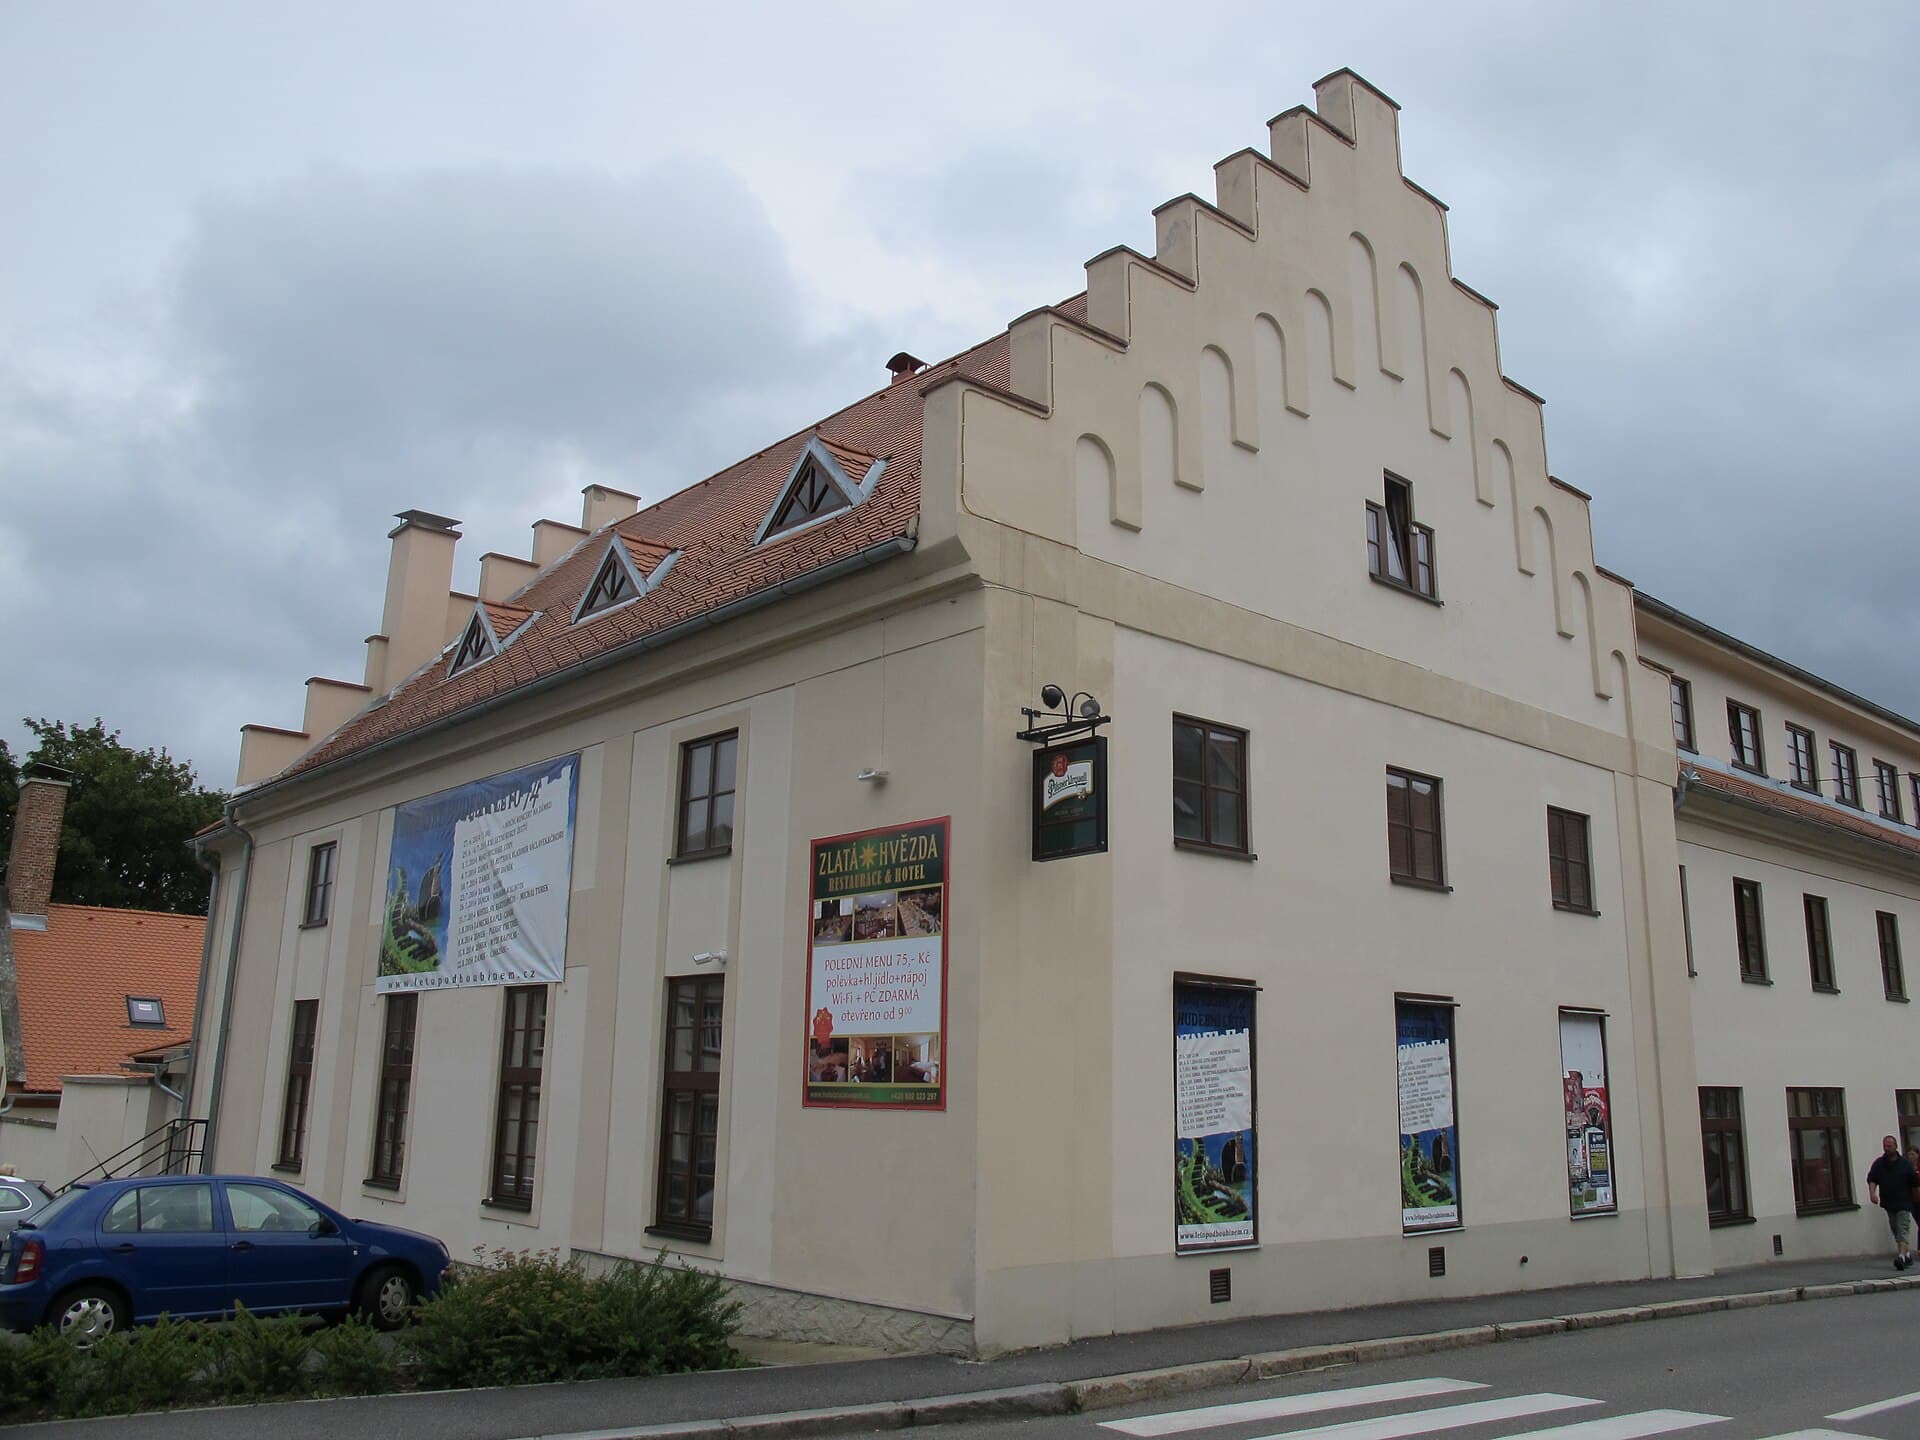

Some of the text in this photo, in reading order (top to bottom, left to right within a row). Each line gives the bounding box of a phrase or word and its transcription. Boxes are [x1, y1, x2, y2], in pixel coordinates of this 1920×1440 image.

[1048, 771, 1087, 799] Pilsner Urquell
[819, 833, 938, 875] ZLATÁ HVĚZDA
[828, 864, 925, 892] RESTAURACE & HOTEL
[824, 951, 931, 971] POLEDNÍ MENU 75,- Kč
[832, 989, 919, 1005] Wi-Fi + PC ZDARMA
[841, 1008, 881, 1022] otevřeno
[883, 1006, 895, 1020] od
